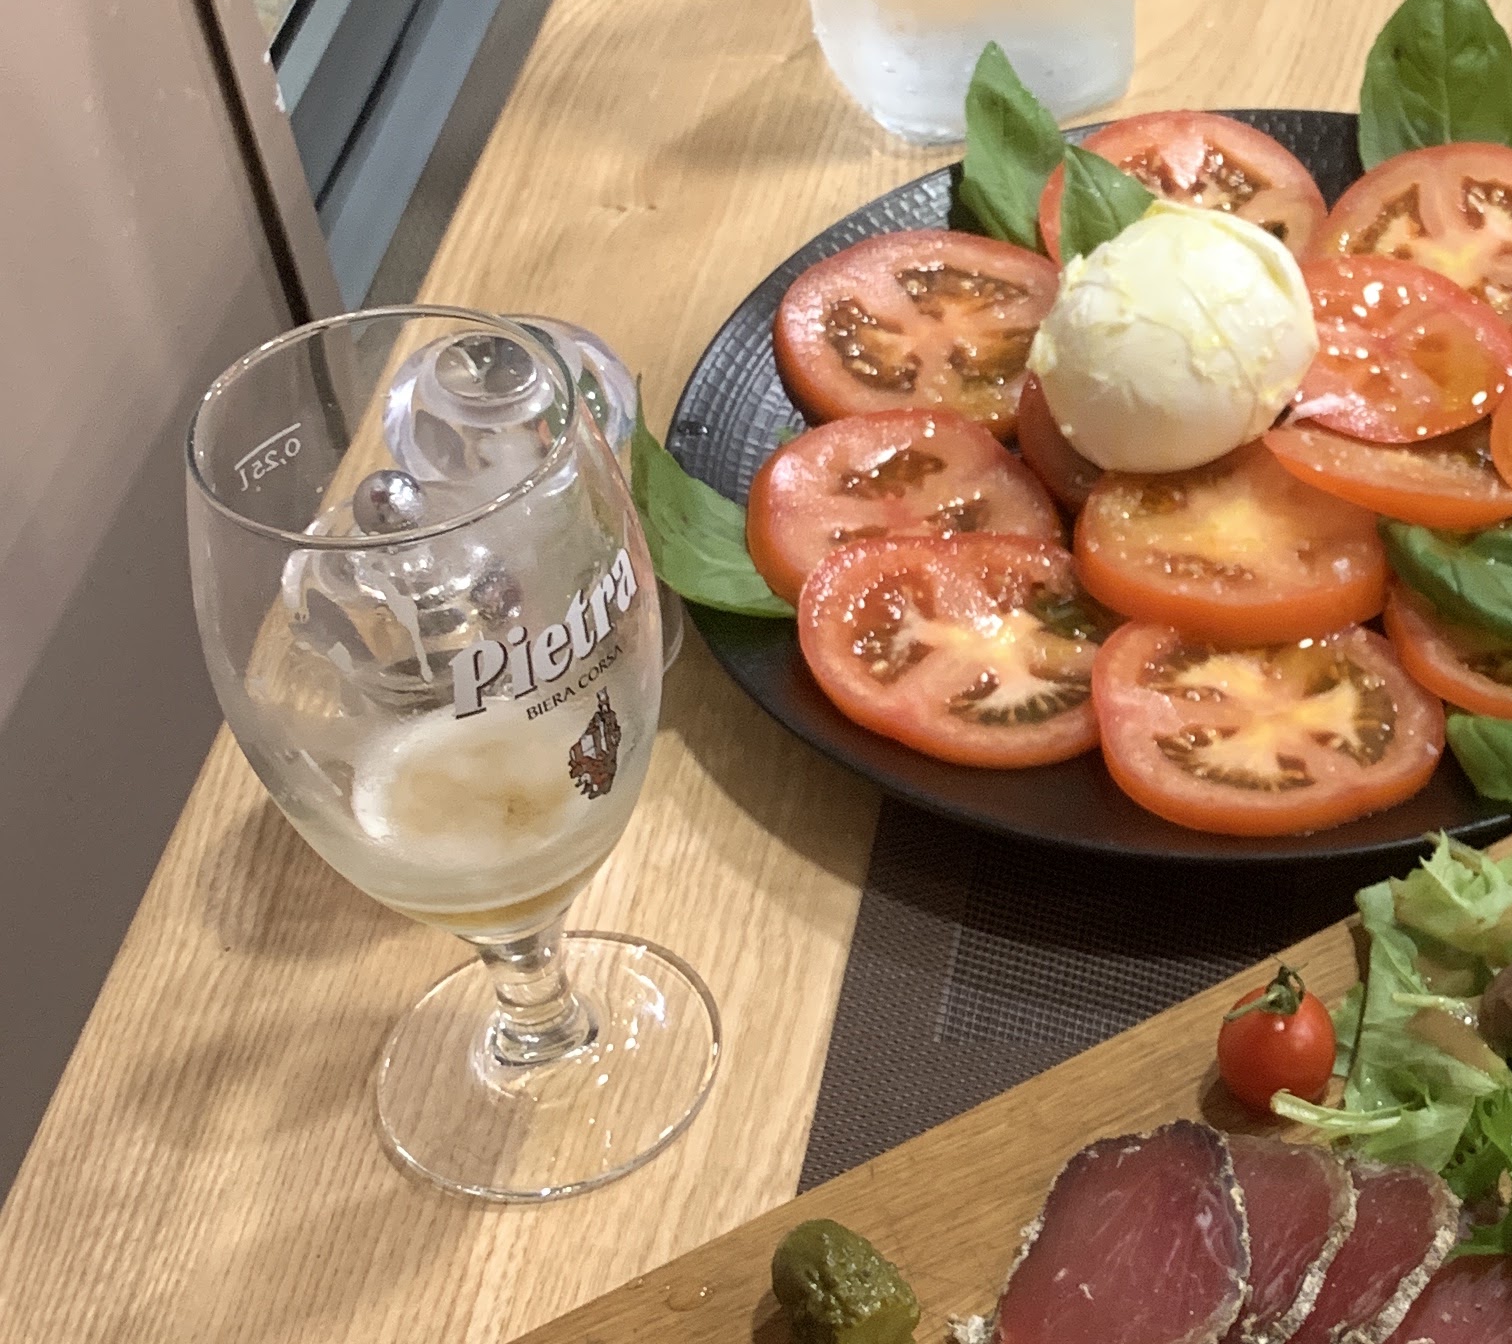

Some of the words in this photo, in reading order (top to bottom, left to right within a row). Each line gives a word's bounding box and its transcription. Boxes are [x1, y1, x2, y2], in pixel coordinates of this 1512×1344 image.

[449, 547, 639, 719] Pietra
[526, 685, 576, 720] BIERA
[578, 644, 623, 689] CORSA
